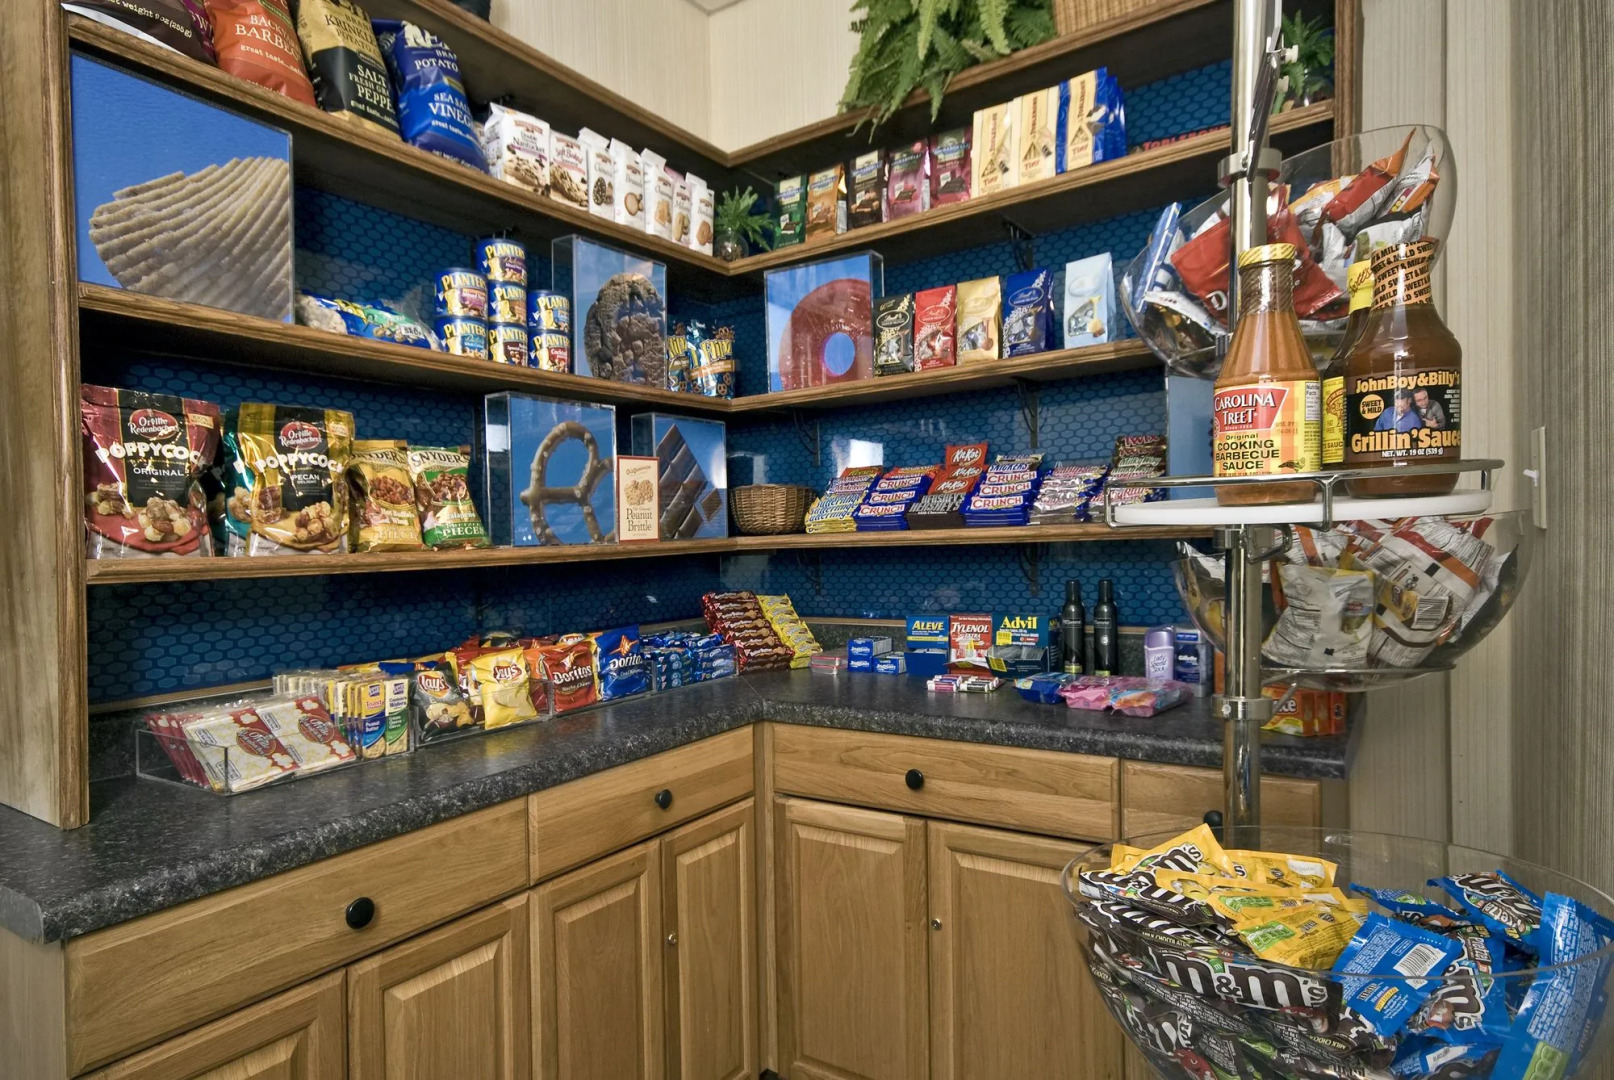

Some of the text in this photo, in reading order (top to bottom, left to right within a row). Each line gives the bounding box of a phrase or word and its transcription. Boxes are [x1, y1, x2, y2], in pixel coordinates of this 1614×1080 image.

[123, 0, 154, 18] weight
[241, 44, 264, 57] great
[357, 63, 387, 88] SALT
[433, 91, 454, 104] SEA
[1378, 265, 1399, 283] SWEET
[1379, 289, 1398, 303] MILD
[1215, 391, 1276, 413] CAROLINA
[1362, 399, 1382, 408] SWEET
[1367, 406, 1382, 415] MILD
[1223, 408, 1255, 426] TREET
[1225, 433, 1259, 441] Original
[1217, 440, 1275, 452] COOKING
[1425, 447, 1438, 456] (539
[1216, 449, 1280, 462] BARBECUE
[1222, 460, 1264, 471] SAUCE
[133, 467, 185, 477] ORIGINAL
[291, 473, 320, 481] PECAN
[988, 472, 1035, 483] CRUNCH
[878, 477, 920, 489] CRUNCH
[981, 484, 1030, 495] CRUNCH
[871, 491, 914, 503] CRUNCH
[973, 498, 1022, 509] CRUNCH
[626, 508, 652, 520] Peanut
[860, 504, 904, 516] CRUNCH
[628, 520, 652, 532] Brittle
[912, 620, 944, 631] ALEVE
[951, 622, 989, 633] TYLENOL
[1001, 616, 1037, 630] Advil
[552, 665, 593, 685] Doritos
